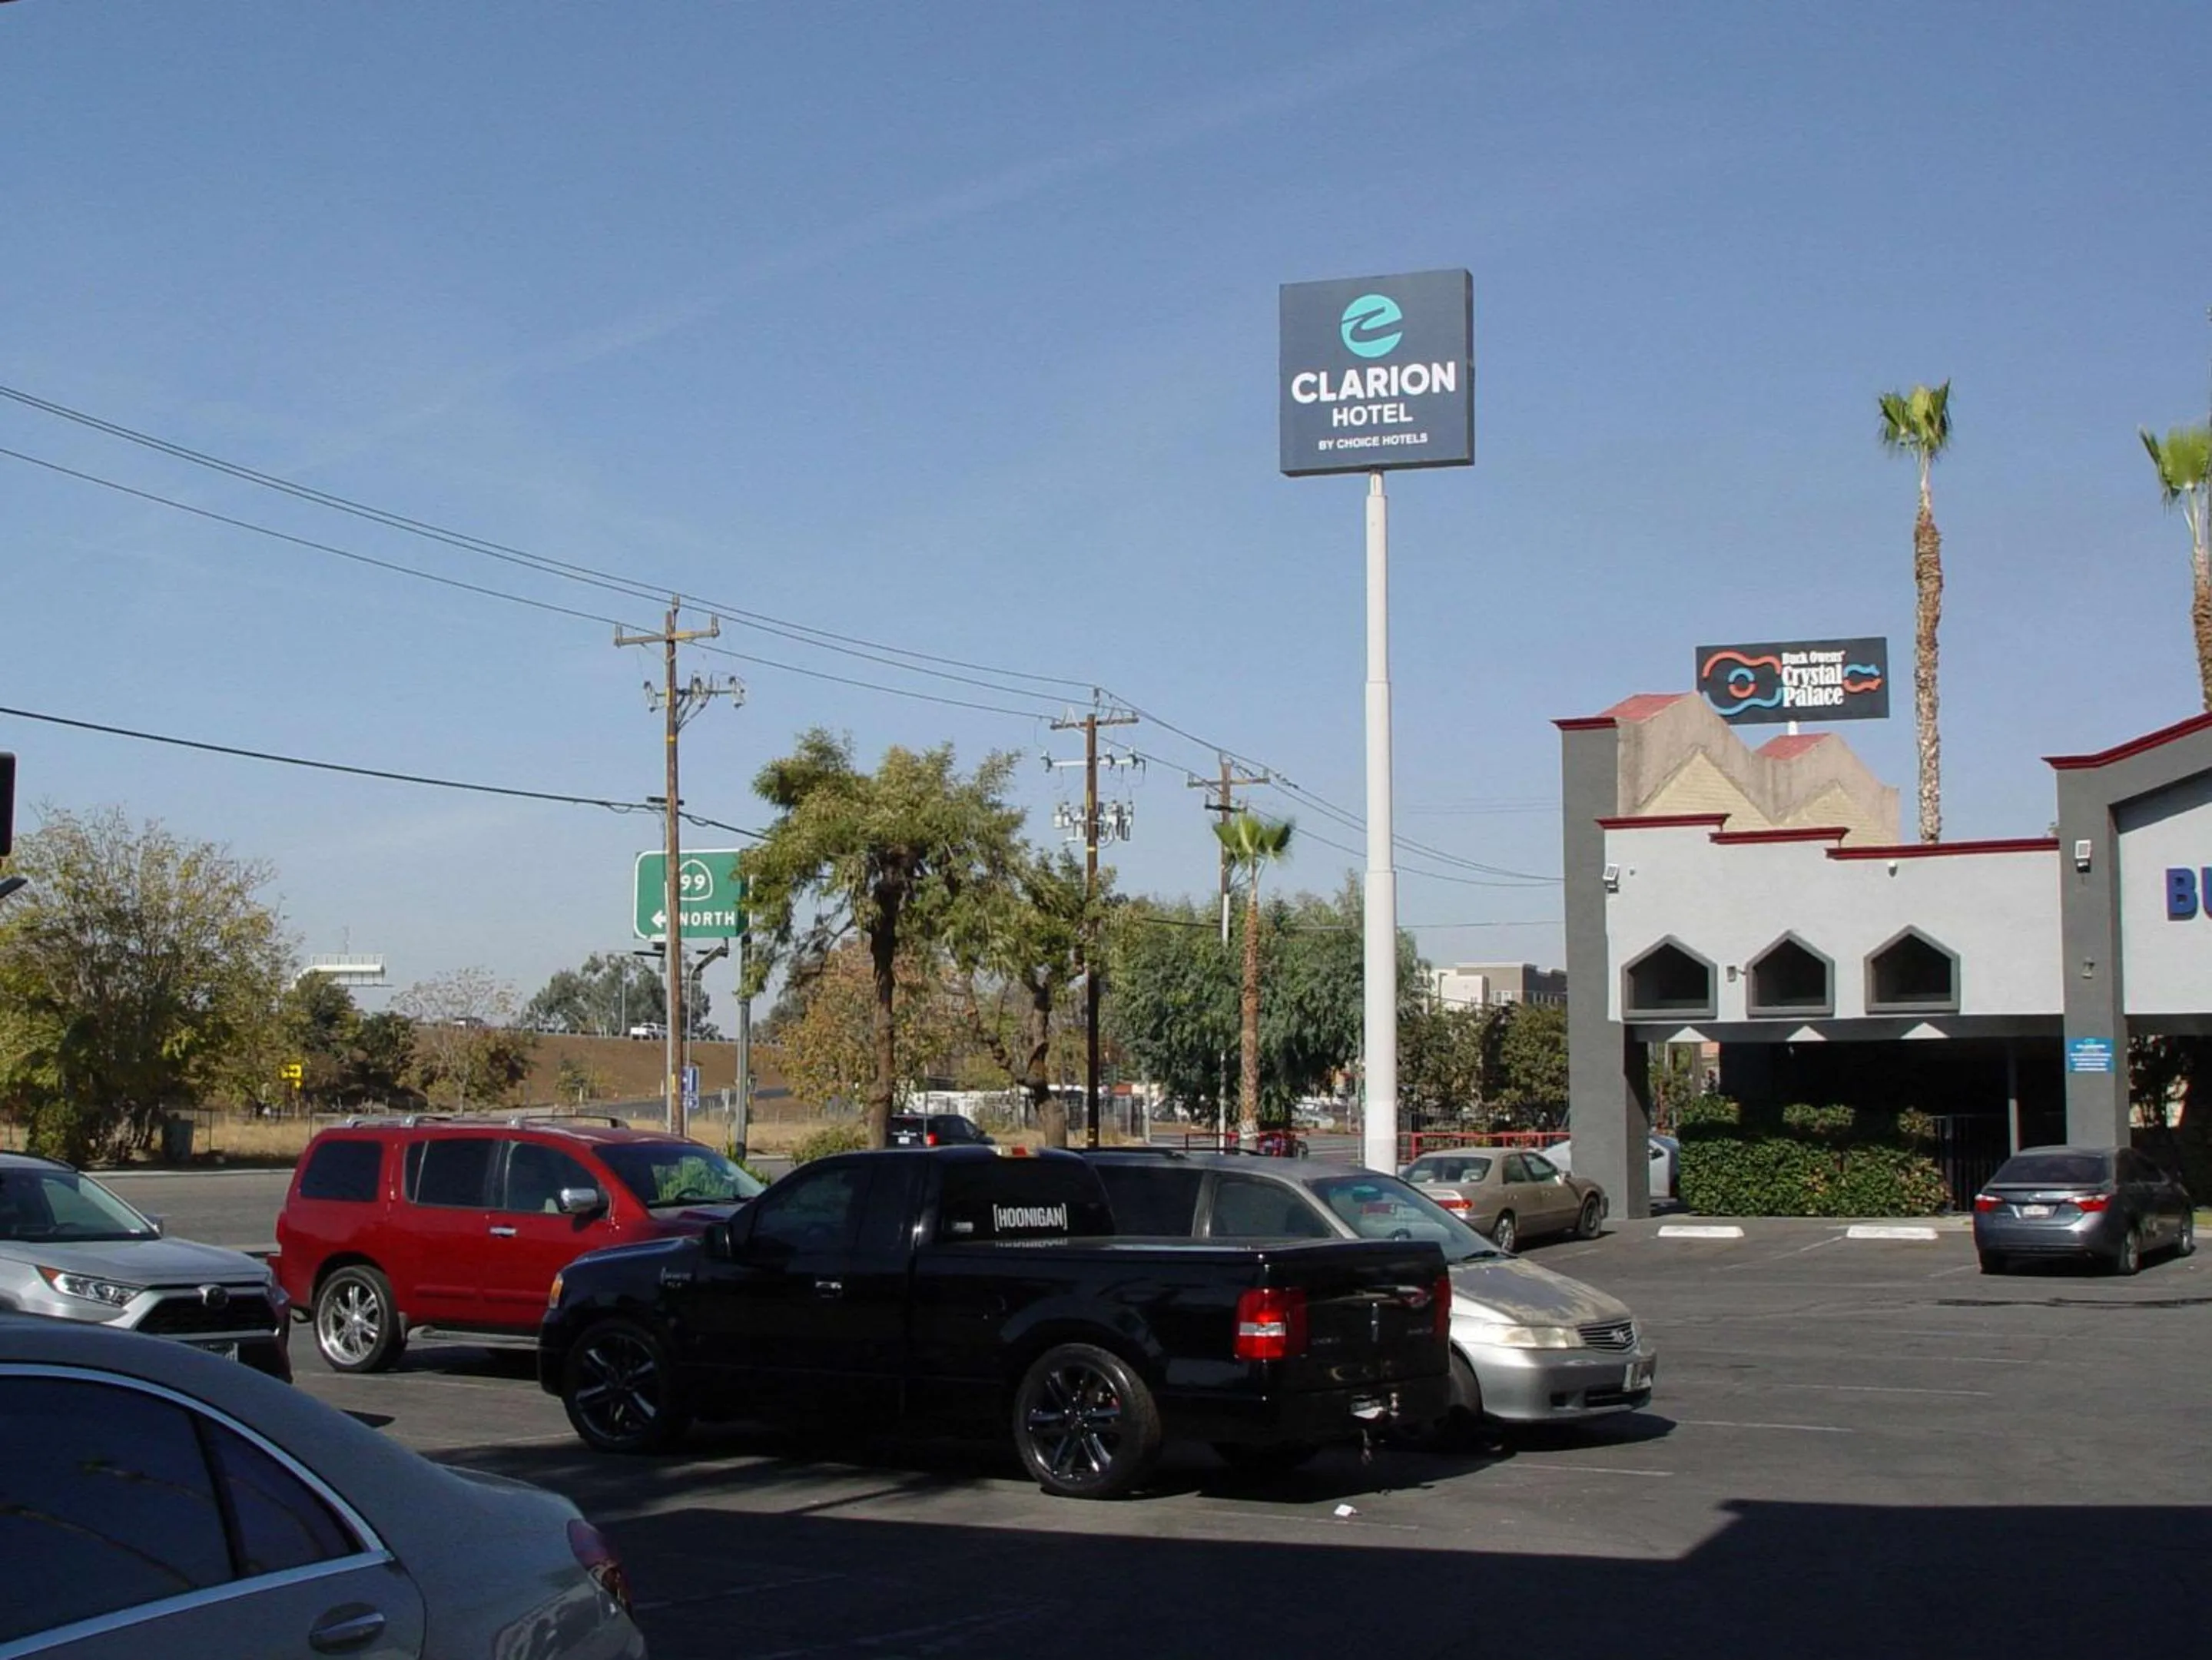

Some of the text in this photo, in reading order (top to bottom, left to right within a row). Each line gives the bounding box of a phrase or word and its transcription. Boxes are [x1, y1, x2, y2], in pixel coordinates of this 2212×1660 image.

[1292, 362, 1455, 403] CLARION
[1332, 403, 1413, 427] HOTEL
[1318, 432, 1428, 450] BY CHOICE HOTELS
[1782, 664, 1842, 688] Crystal
[1783, 686, 1844, 707] Palace
[680, 874, 705, 890] 99
[680, 912, 735, 925] NORTH
